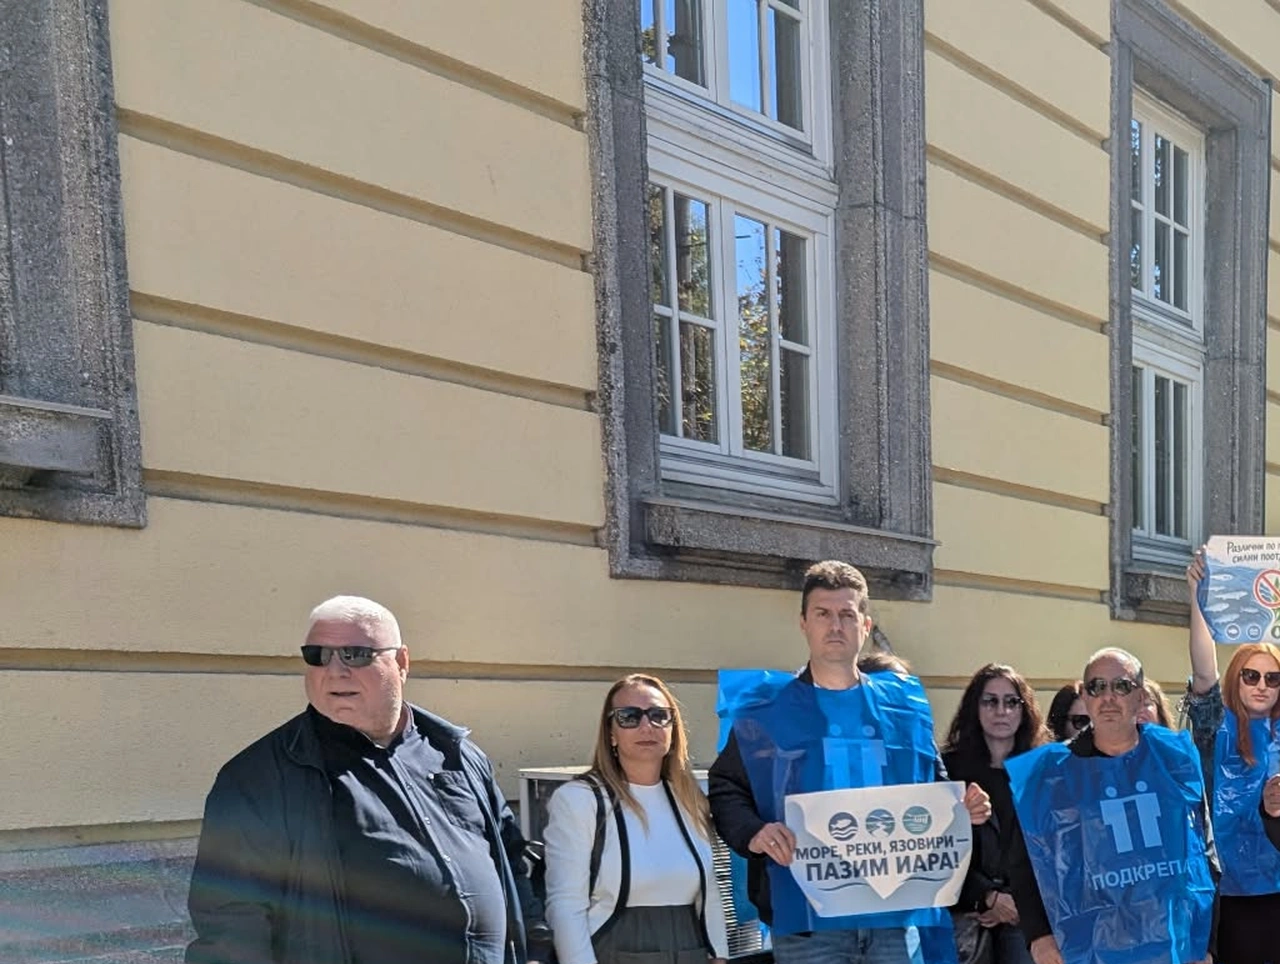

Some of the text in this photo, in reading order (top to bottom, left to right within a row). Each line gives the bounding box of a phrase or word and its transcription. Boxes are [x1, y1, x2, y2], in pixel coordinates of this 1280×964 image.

[795, 845, 842, 861] МОРЕ,
[847, 842, 887, 857] РЕКИ,
[890, 835, 954, 852] ЯЗОВИРИ
[806, 851, 960, 882] ПАЗИМ ИАРА!
